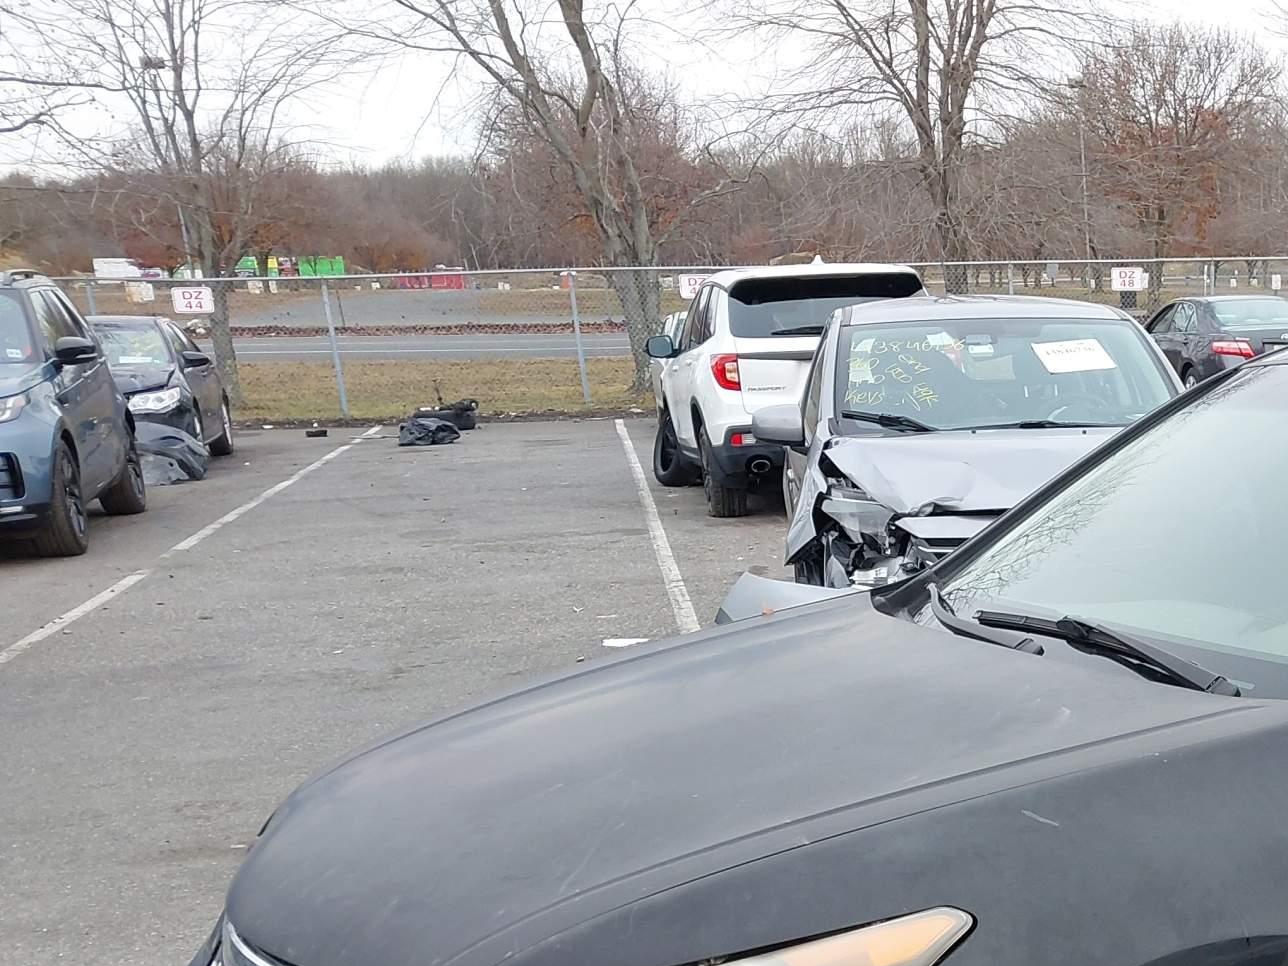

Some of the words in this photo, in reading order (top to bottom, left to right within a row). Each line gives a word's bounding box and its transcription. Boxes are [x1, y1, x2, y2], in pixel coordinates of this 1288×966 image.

[1119, 270, 1136, 279] DZ
[1120, 279, 1135, 287] 48
[182, 290, 204, 300] DZ
[184, 301, 203, 309] 44
